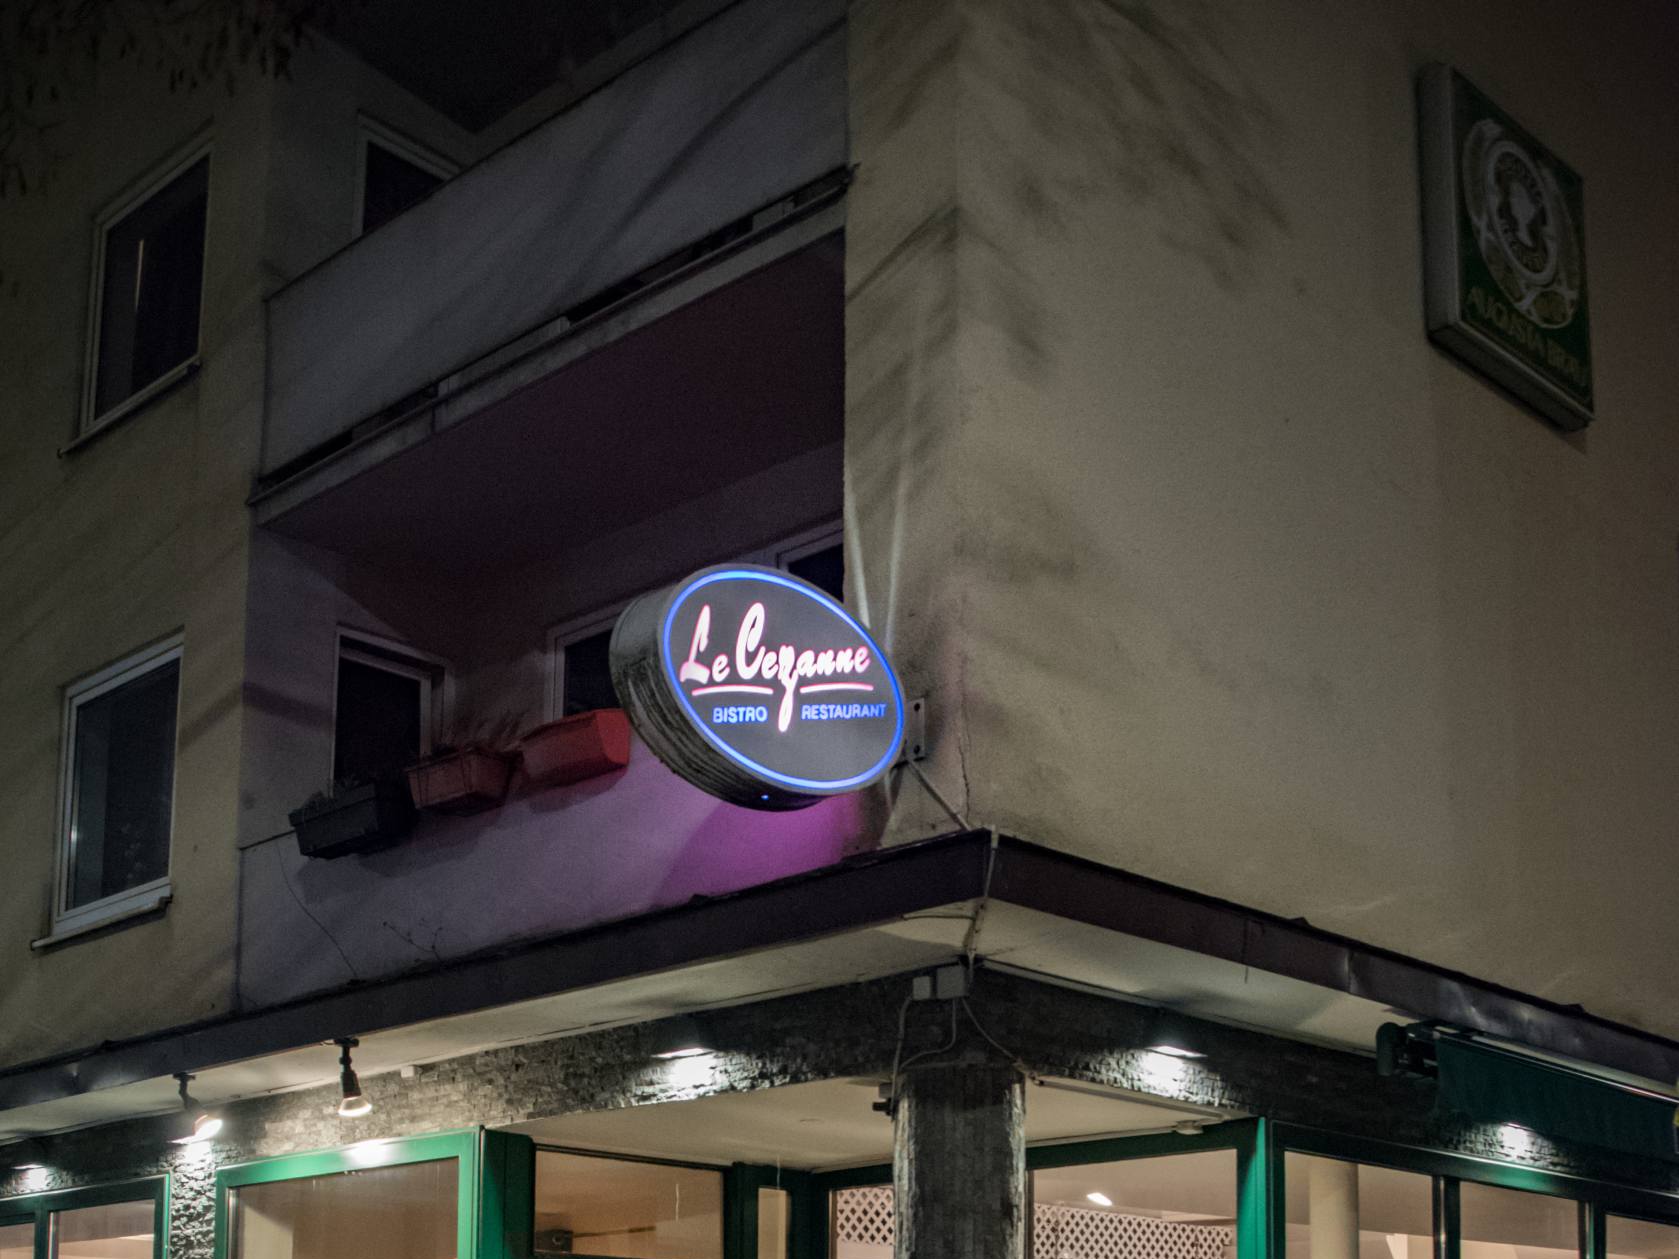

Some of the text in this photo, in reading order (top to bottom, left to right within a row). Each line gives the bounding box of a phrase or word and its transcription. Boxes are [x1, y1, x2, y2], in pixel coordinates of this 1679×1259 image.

[679, 603, 731, 686] Le
[712, 703, 887, 724] BISTRO RESTAURANT
